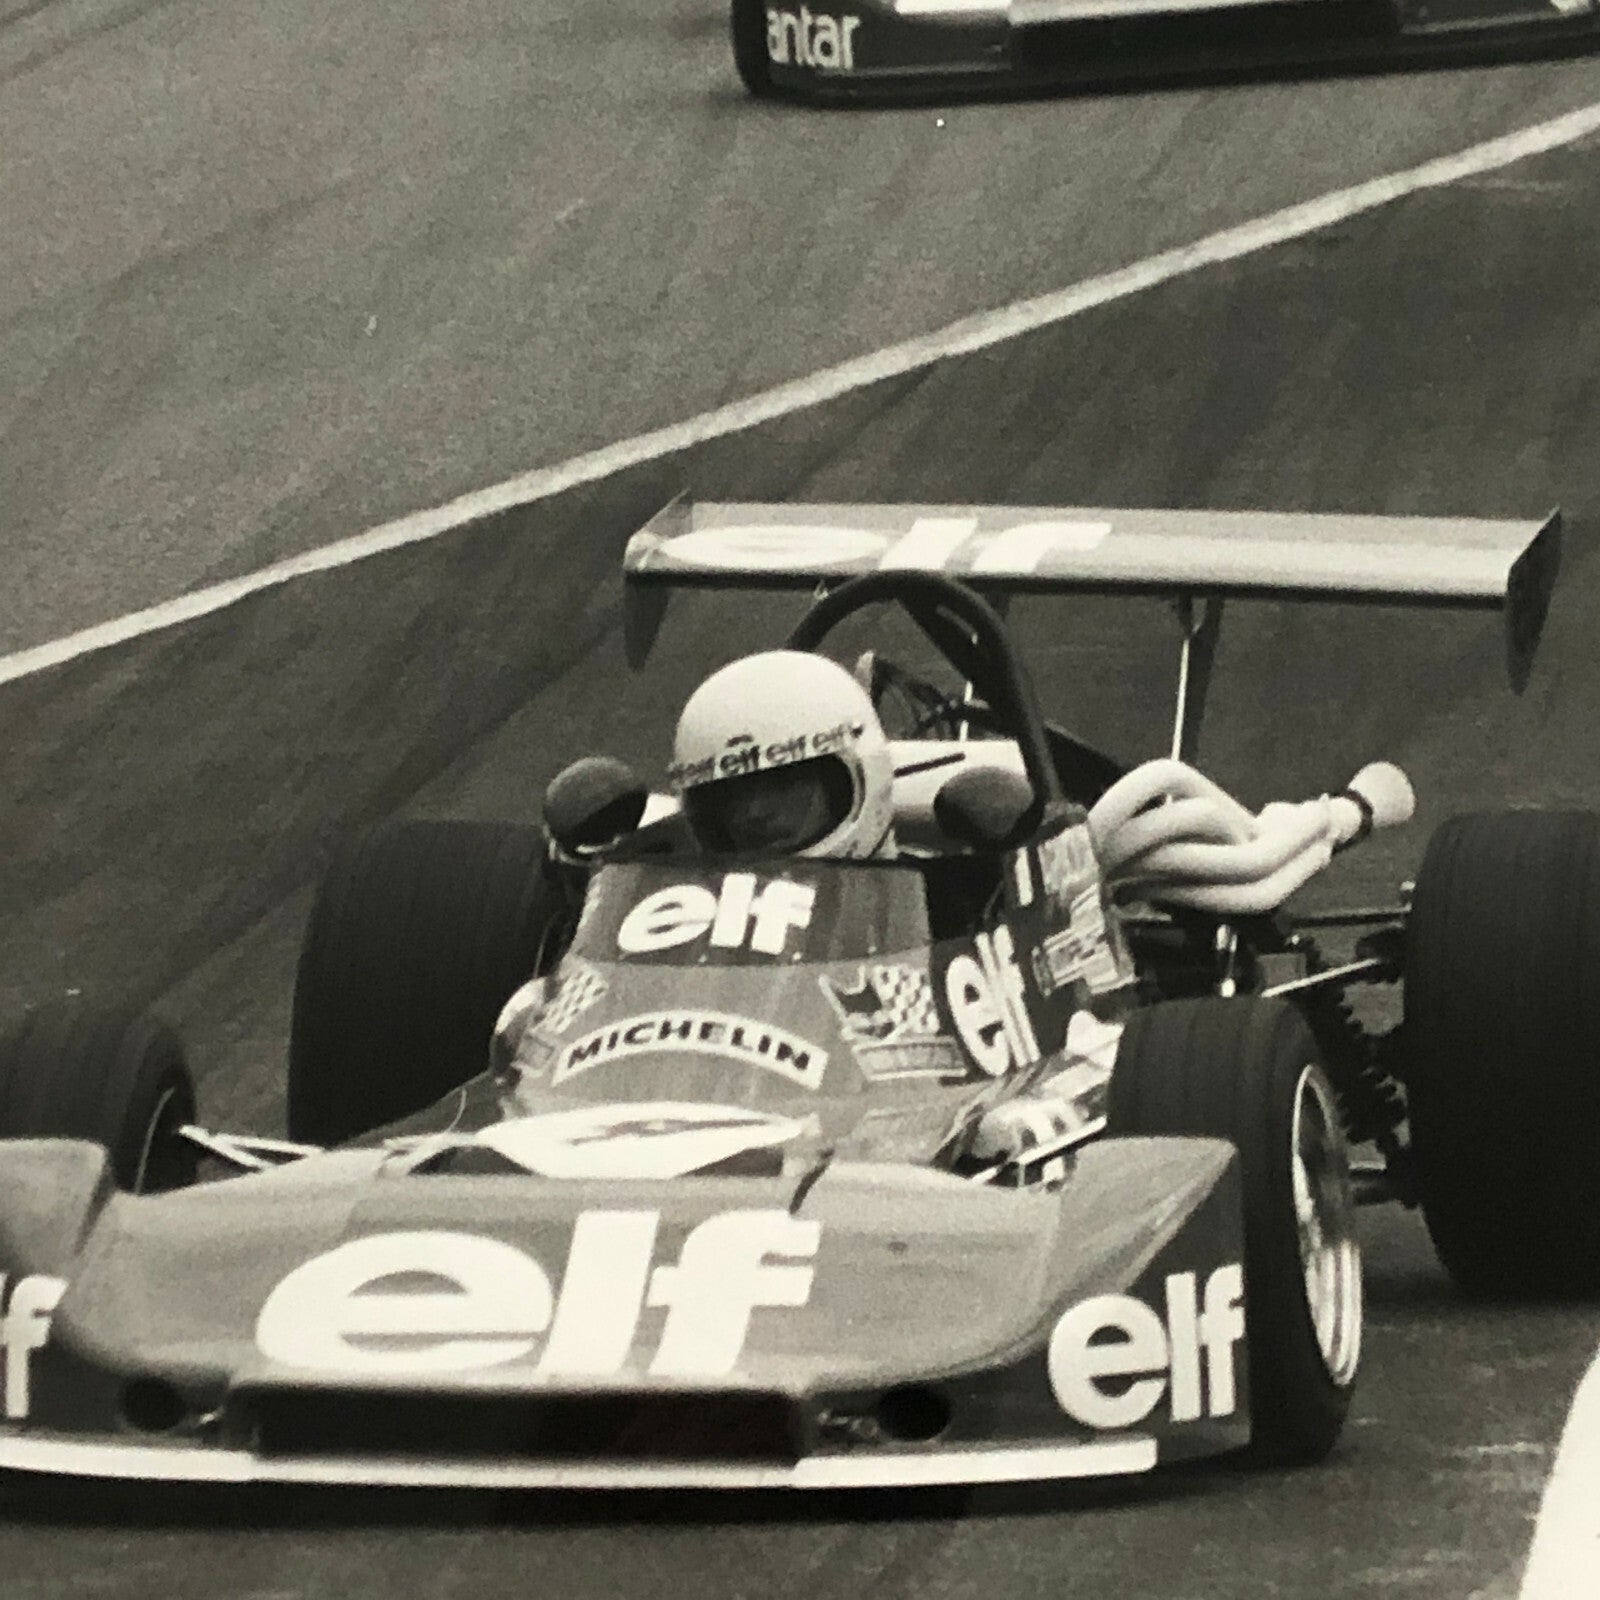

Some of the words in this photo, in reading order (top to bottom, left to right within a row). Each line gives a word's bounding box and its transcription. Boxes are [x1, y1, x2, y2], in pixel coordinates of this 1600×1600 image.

[766, 5, 860, 70] antar
[719, 744, 761, 777] elf
[617, 872, 817, 955] elf
[567, 1018, 812, 1072] MICHELIN
[945, 924, 1040, 1077] elf
[0, 1271, 70, 1419] f
[256, 1209, 822, 1379] elf
[1047, 1262, 1246, 1429] elf
